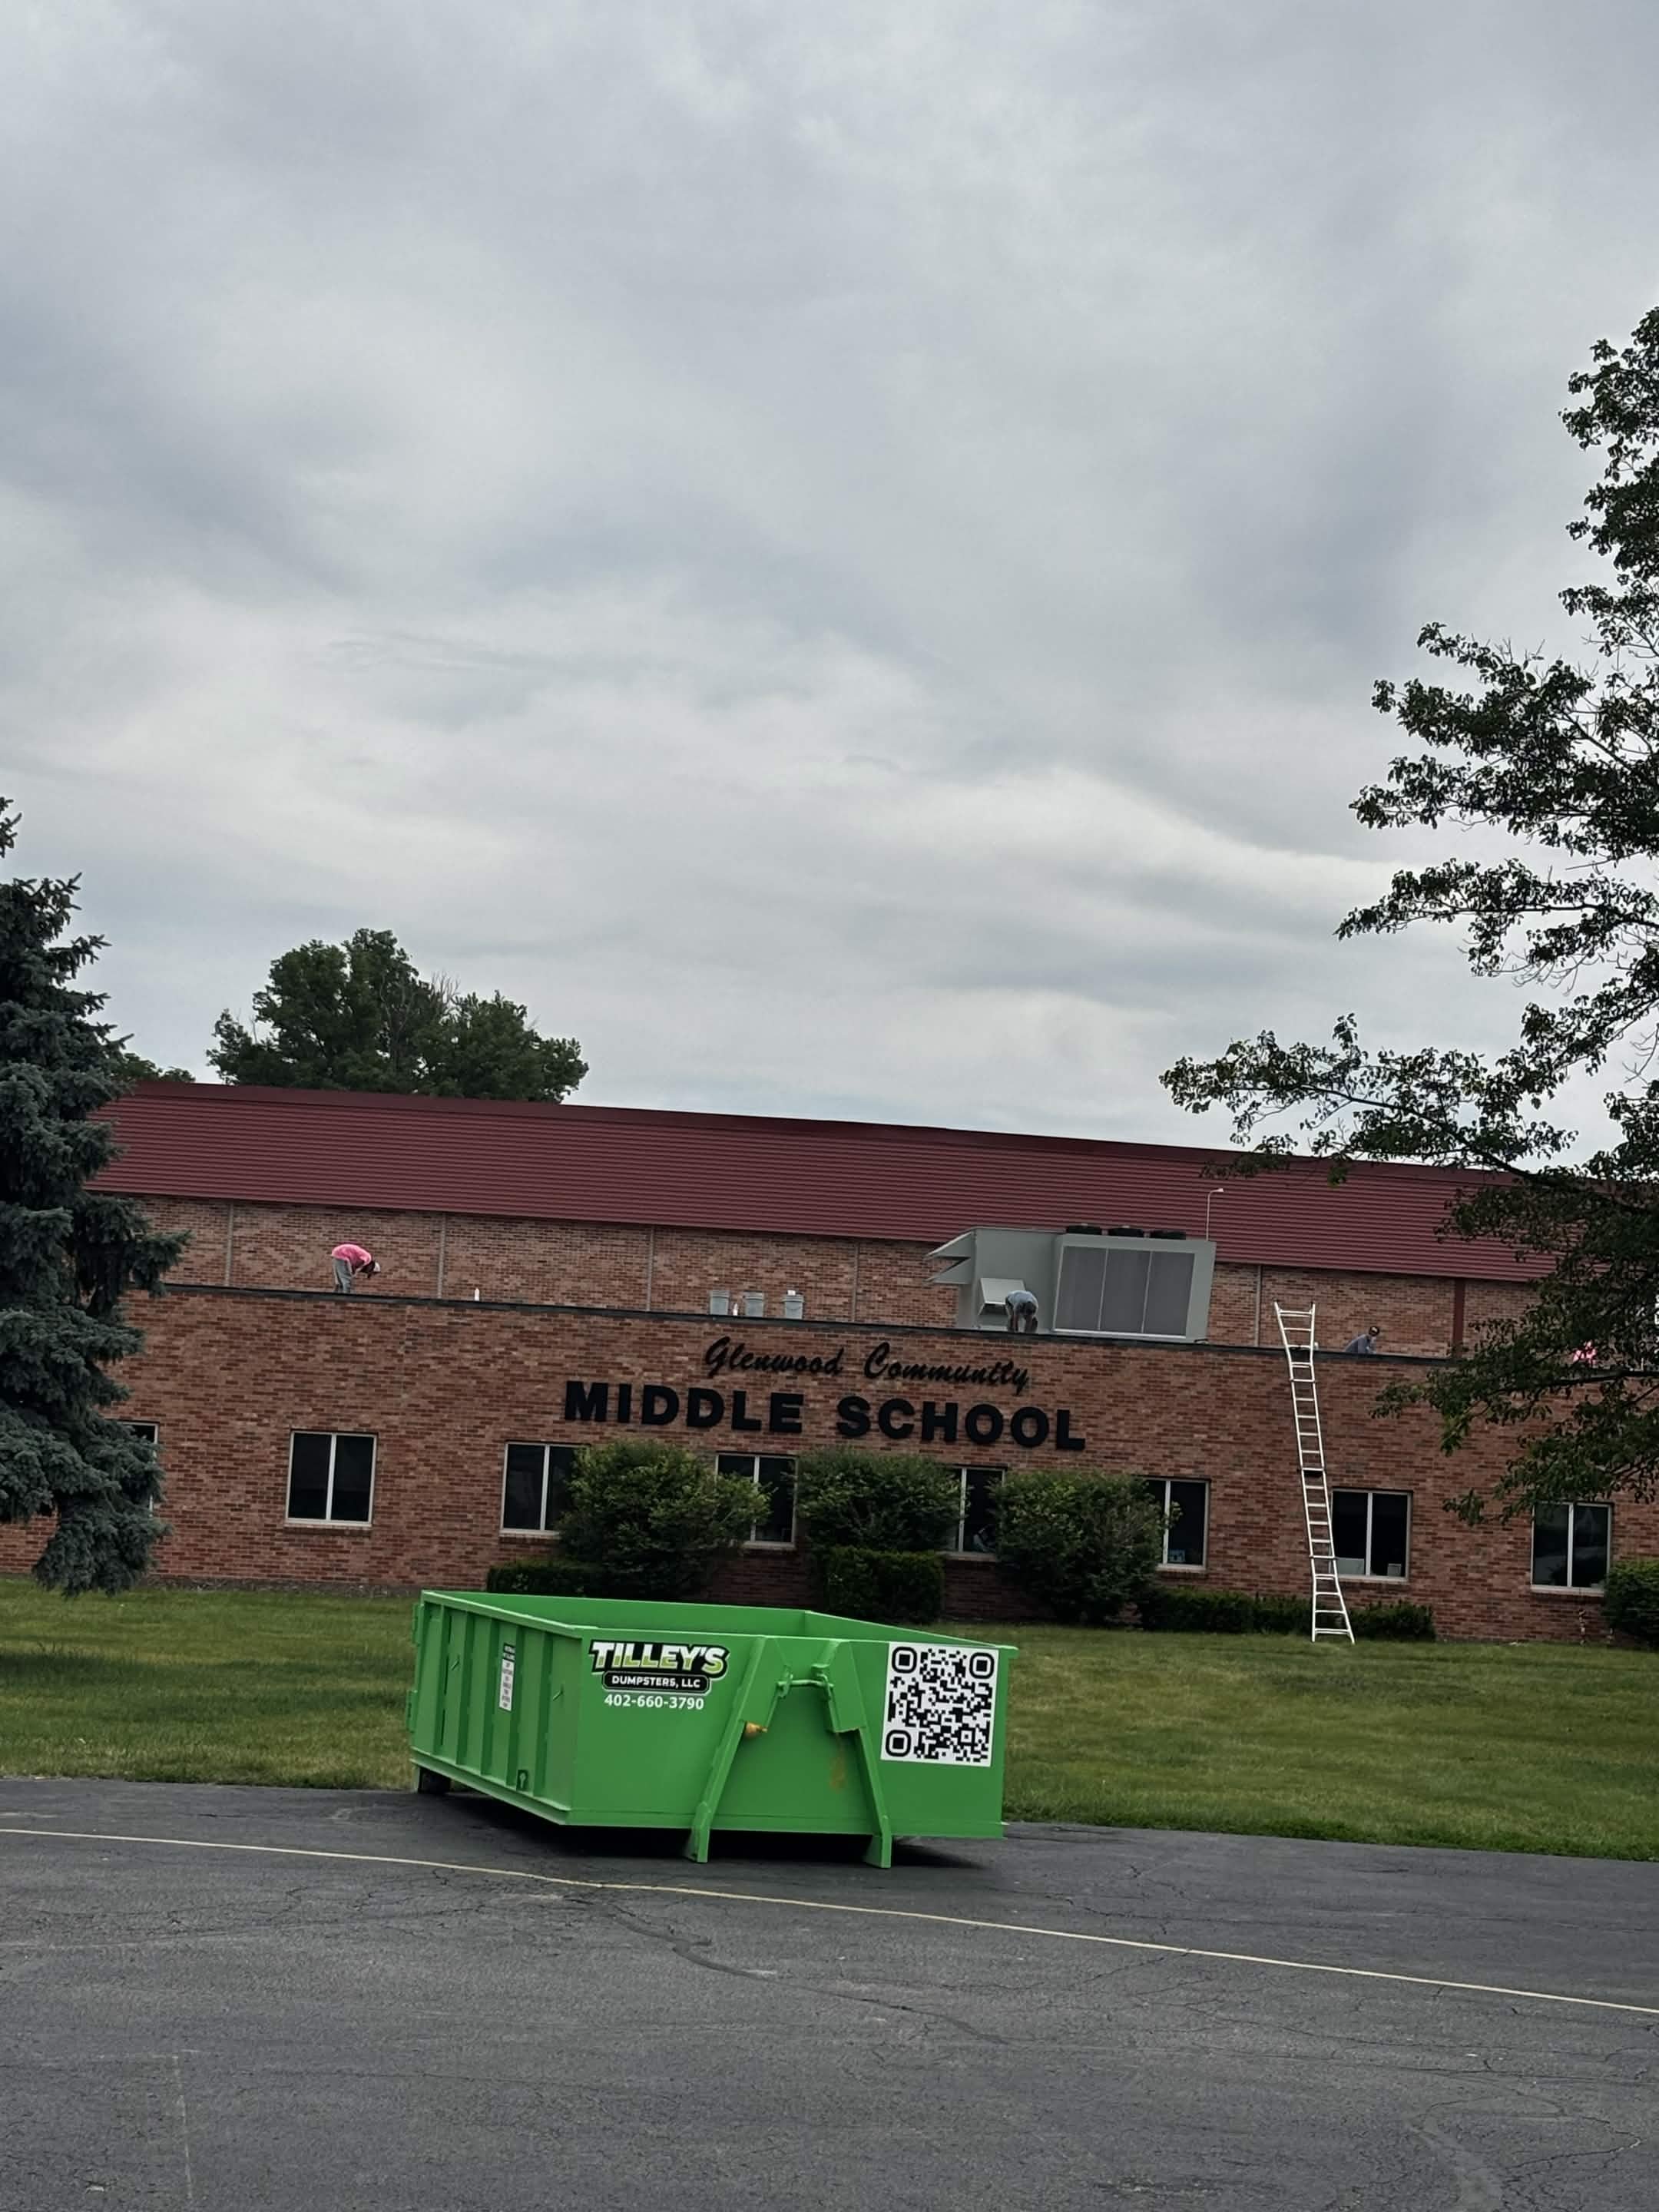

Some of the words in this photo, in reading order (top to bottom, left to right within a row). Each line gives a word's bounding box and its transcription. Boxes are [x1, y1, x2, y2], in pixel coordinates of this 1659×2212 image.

[704, 1336, 844, 1379] Glenwood
[864, 1341, 1030, 1396] Community
[564, 1380, 804, 1433] MIDDLE
[836, 1395, 1086, 1450] SCHOOL
[591, 1641, 727, 1675] TILLEY'S
[611, 1675, 679, 1688] DUMPSTERS,
[681, 1678, 700, 1688] LLC
[604, 1694, 704, 1710] 402-660-3790
